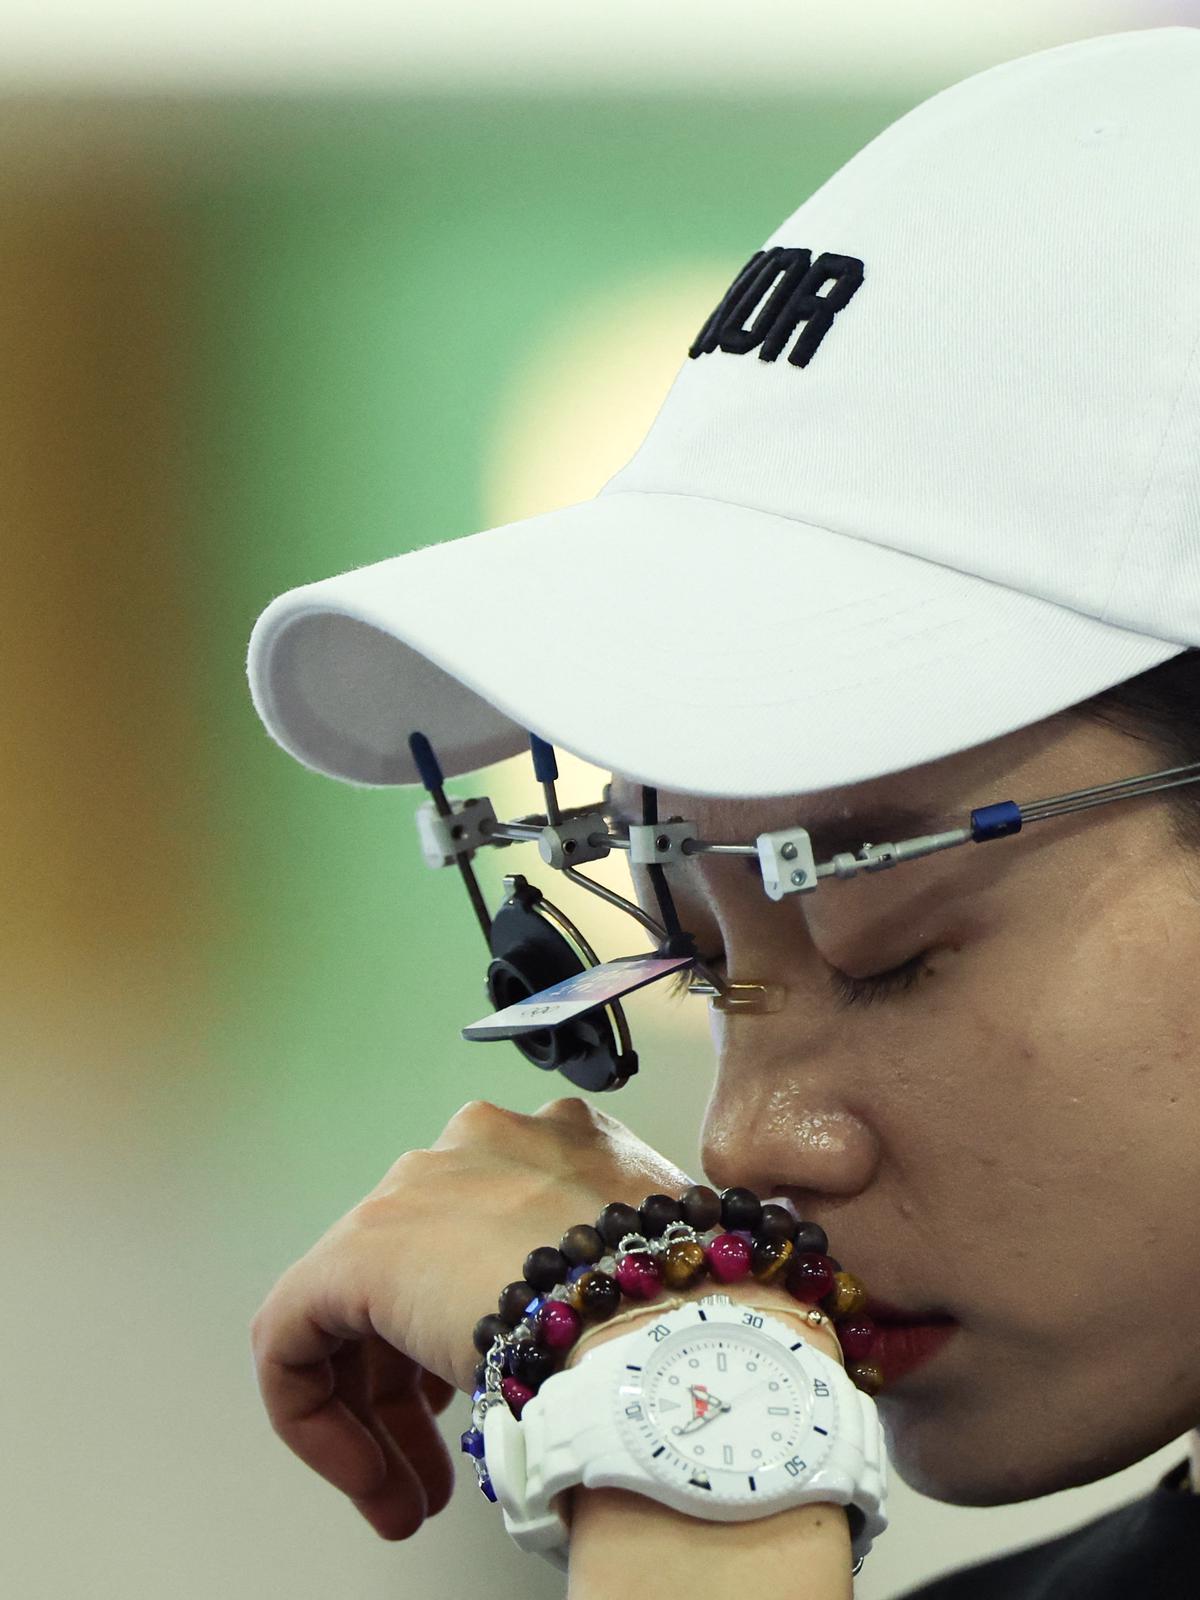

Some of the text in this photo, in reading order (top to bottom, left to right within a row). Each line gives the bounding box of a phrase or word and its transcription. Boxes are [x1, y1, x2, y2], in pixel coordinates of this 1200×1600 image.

[741, 1312, 763, 1328] 30
[648, 1324, 671, 1342] 20
[813, 1378, 829, 1397] 40
[784, 1455, 807, 1477] 50
